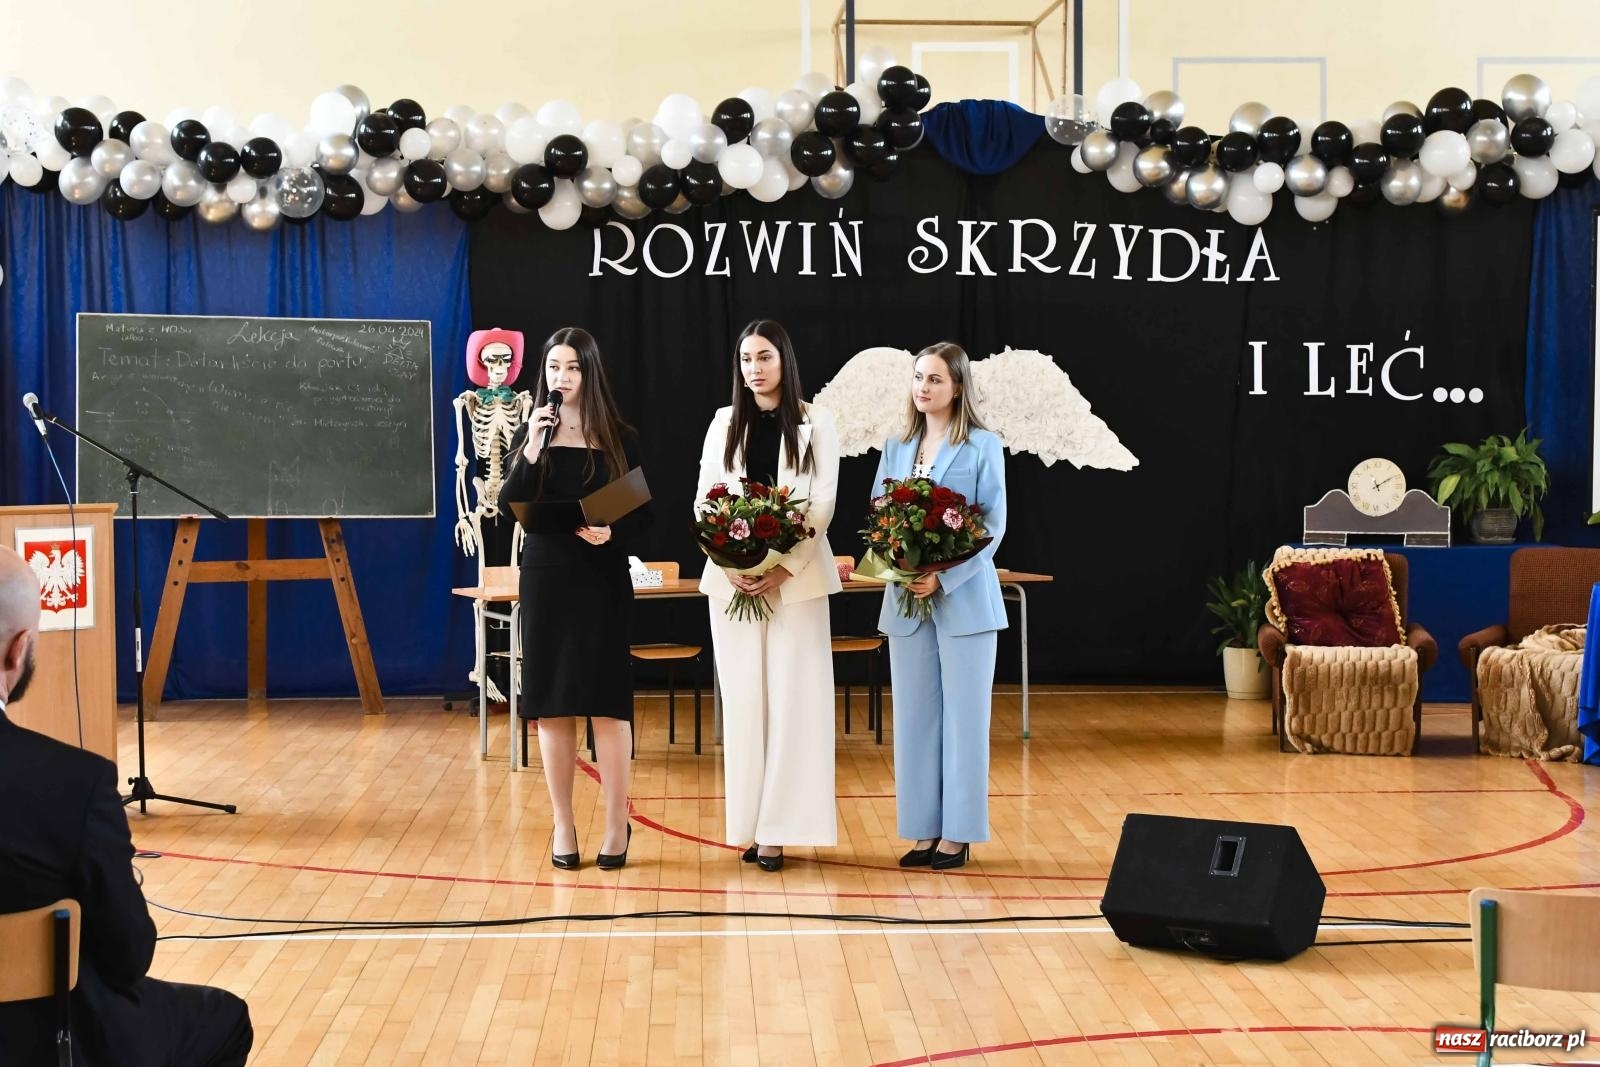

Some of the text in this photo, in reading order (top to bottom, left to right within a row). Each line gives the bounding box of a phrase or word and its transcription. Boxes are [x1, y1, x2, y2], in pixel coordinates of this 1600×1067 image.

[589, 208, 1280, 285] ROZWIŃ SKRZYDŁA
[227, 321, 299, 351] Lekcja
[1248, 330, 1484, 403] I LEĆ...
